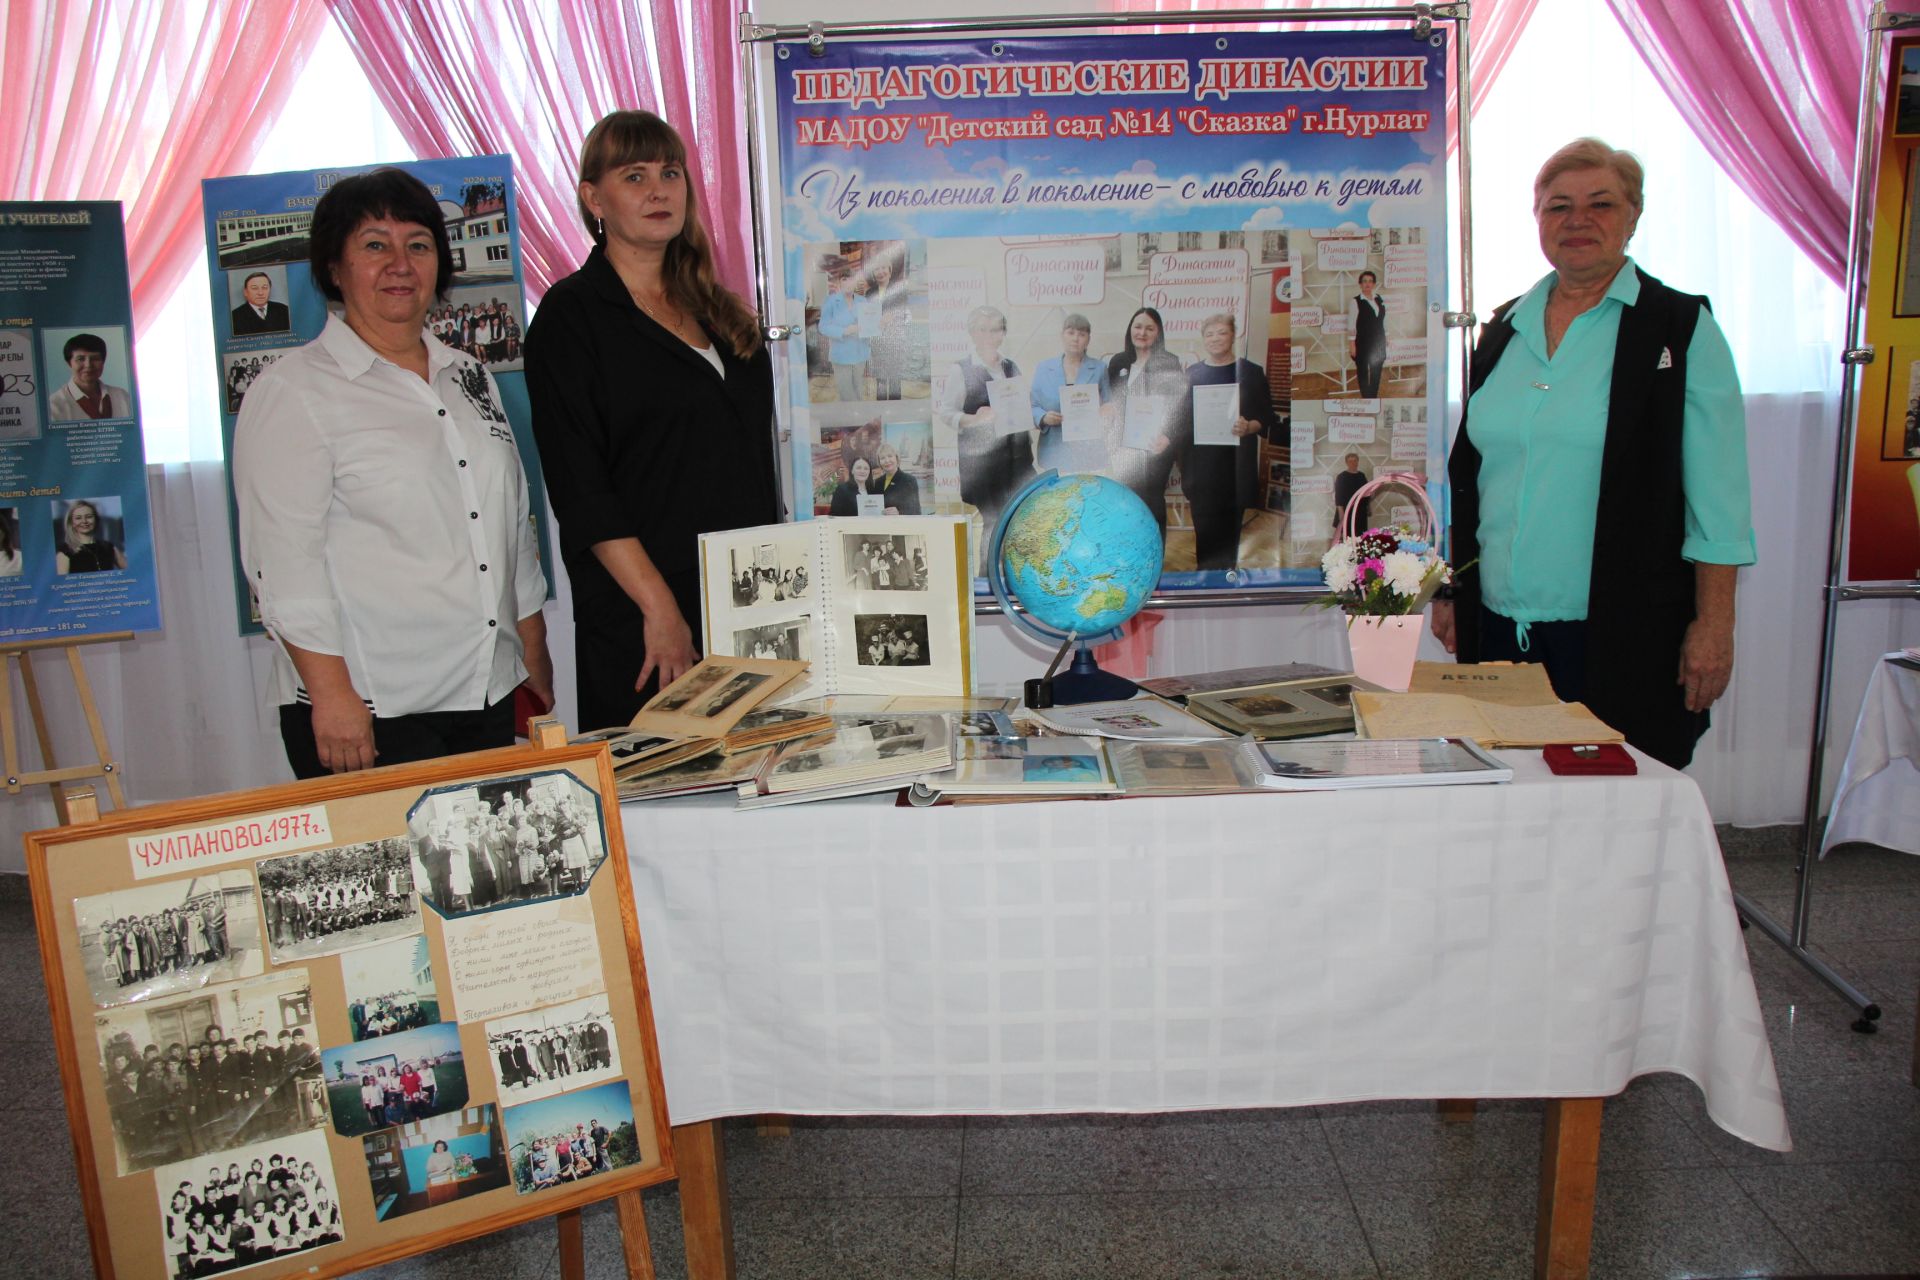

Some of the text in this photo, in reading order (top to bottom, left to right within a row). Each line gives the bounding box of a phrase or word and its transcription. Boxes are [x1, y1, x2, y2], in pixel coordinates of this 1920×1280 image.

[793, 57, 1427, 109] ПЕДАГОГИЧЕСКИЕ ДИНАСТИИ
[799, 107, 1427, 148] МАДОУ "Детский сад №14 "Сказка" г.Нурлат
[800, 169, 862, 219] Из
[867, 185, 995, 209] поколения
[1002, 174, 1022, 204] в
[1182, 182, 1196, 199] с
[1202, 168, 1309, 200] любовью
[1315, 180, 1332, 197] к
[1339, 176, 1424, 207] детям
[7, 210, 90, 224] УЧИТЕЛЕЙ
[1011, 254, 1099, 274] Династии
[1162, 255, 1235, 272] Династии
[1149, 287, 1240, 309] Династии
[136, 823, 262, 867] ЧУЛПАНОВО
